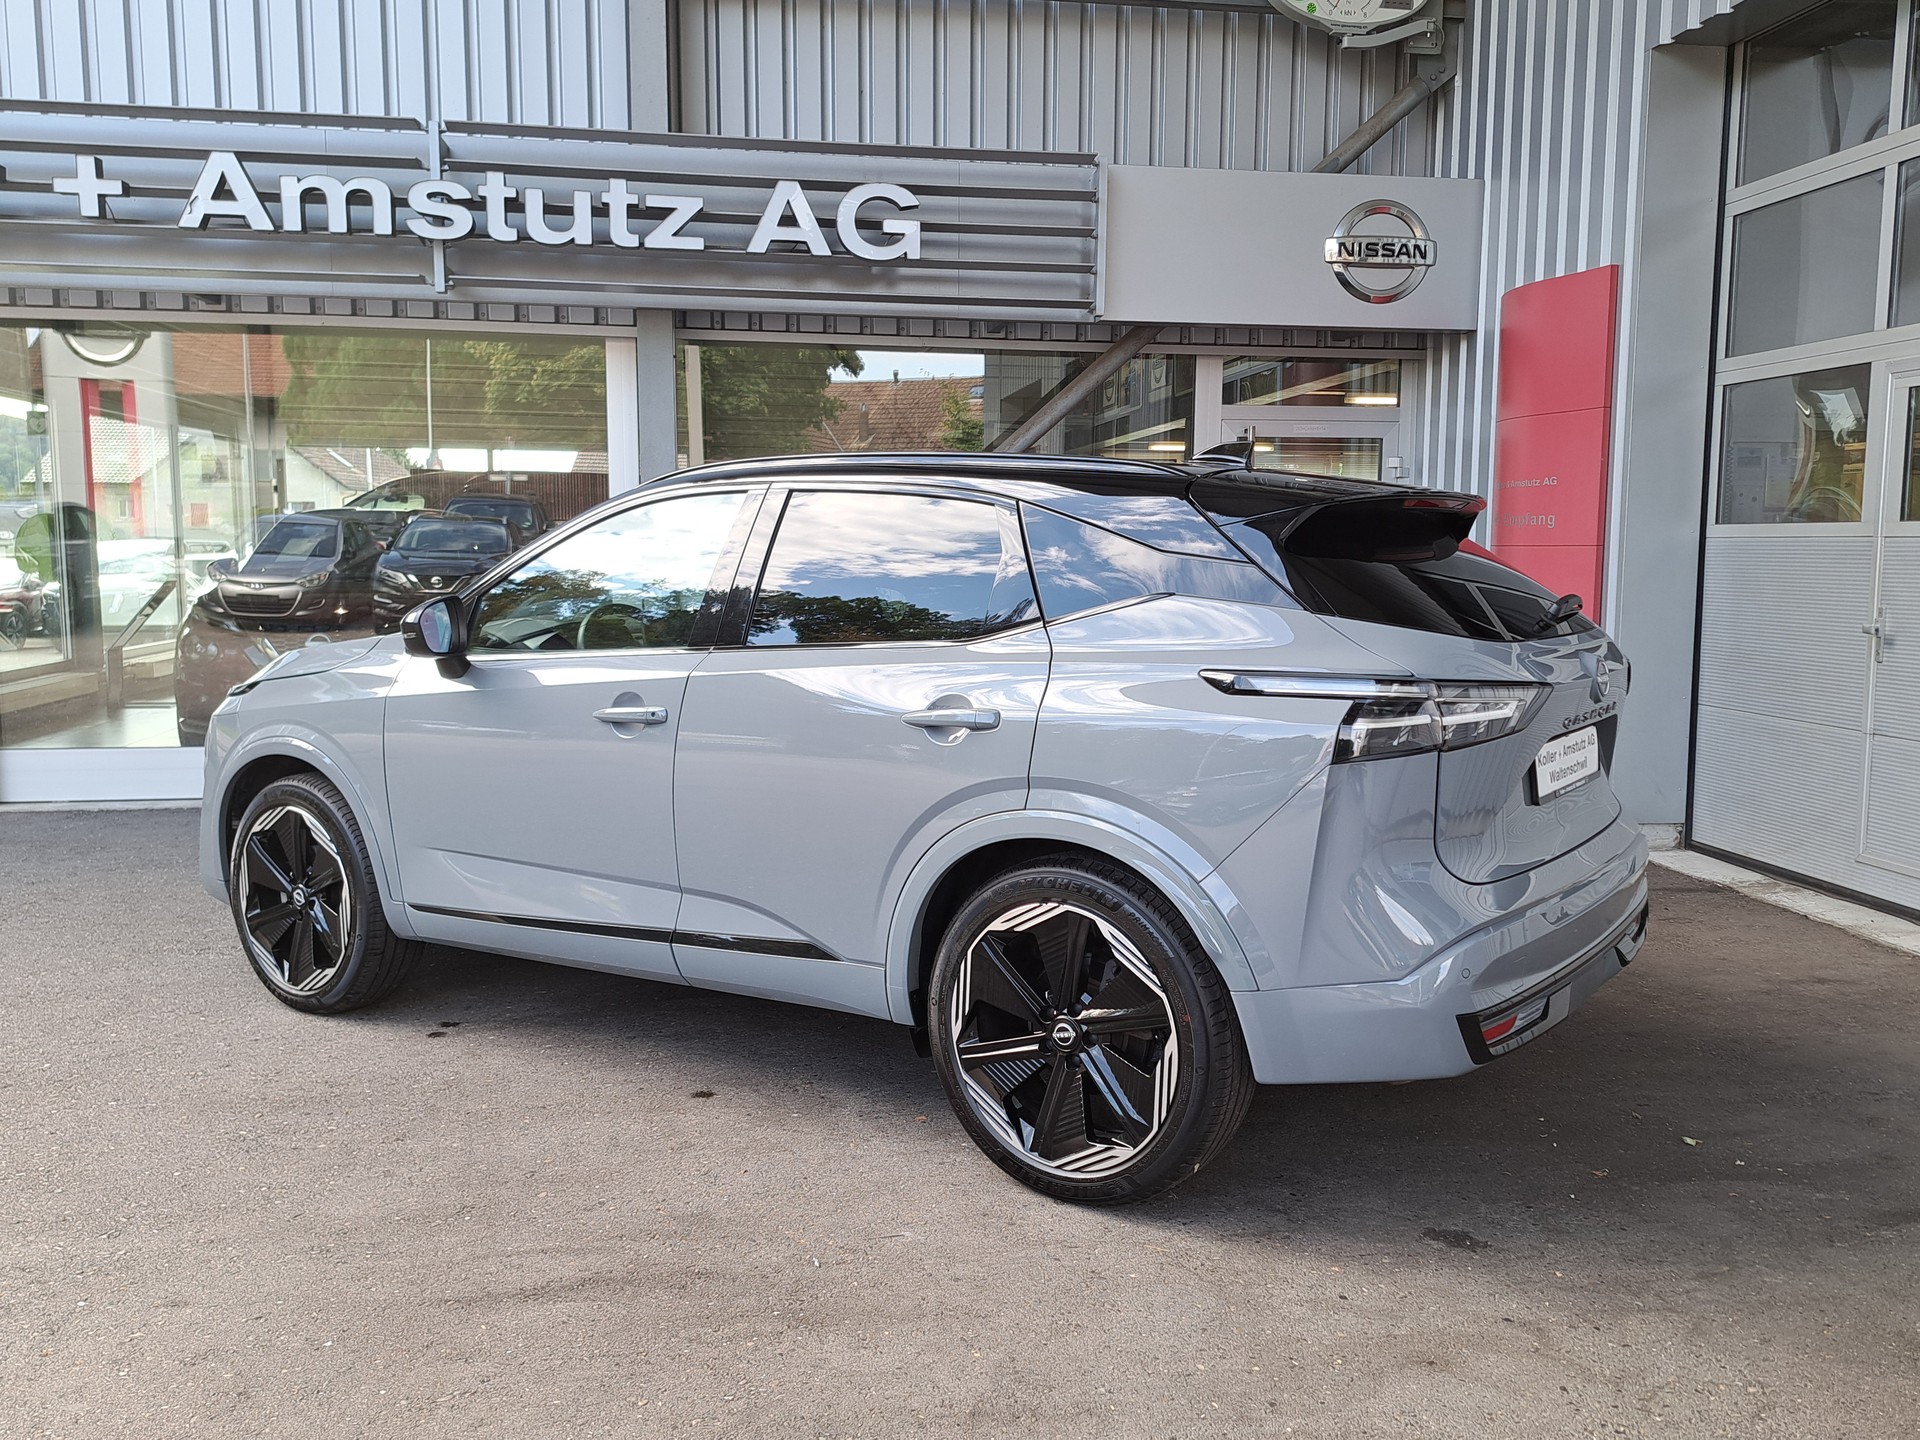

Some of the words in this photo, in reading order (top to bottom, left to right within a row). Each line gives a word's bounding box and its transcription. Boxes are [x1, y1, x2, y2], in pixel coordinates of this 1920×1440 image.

[177, 151, 705, 251] Amstutz
[746, 180, 922, 262] AG
[1337, 241, 1428, 260] NISSAN
[1542, 476, 1558, 486] AG
[1537, 750, 1557, 768] Koller
[1562, 738, 1587, 759] Amstutz
[1587, 733, 1596, 748] AG
[1549, 756, 1588, 784] Waltenschwil
